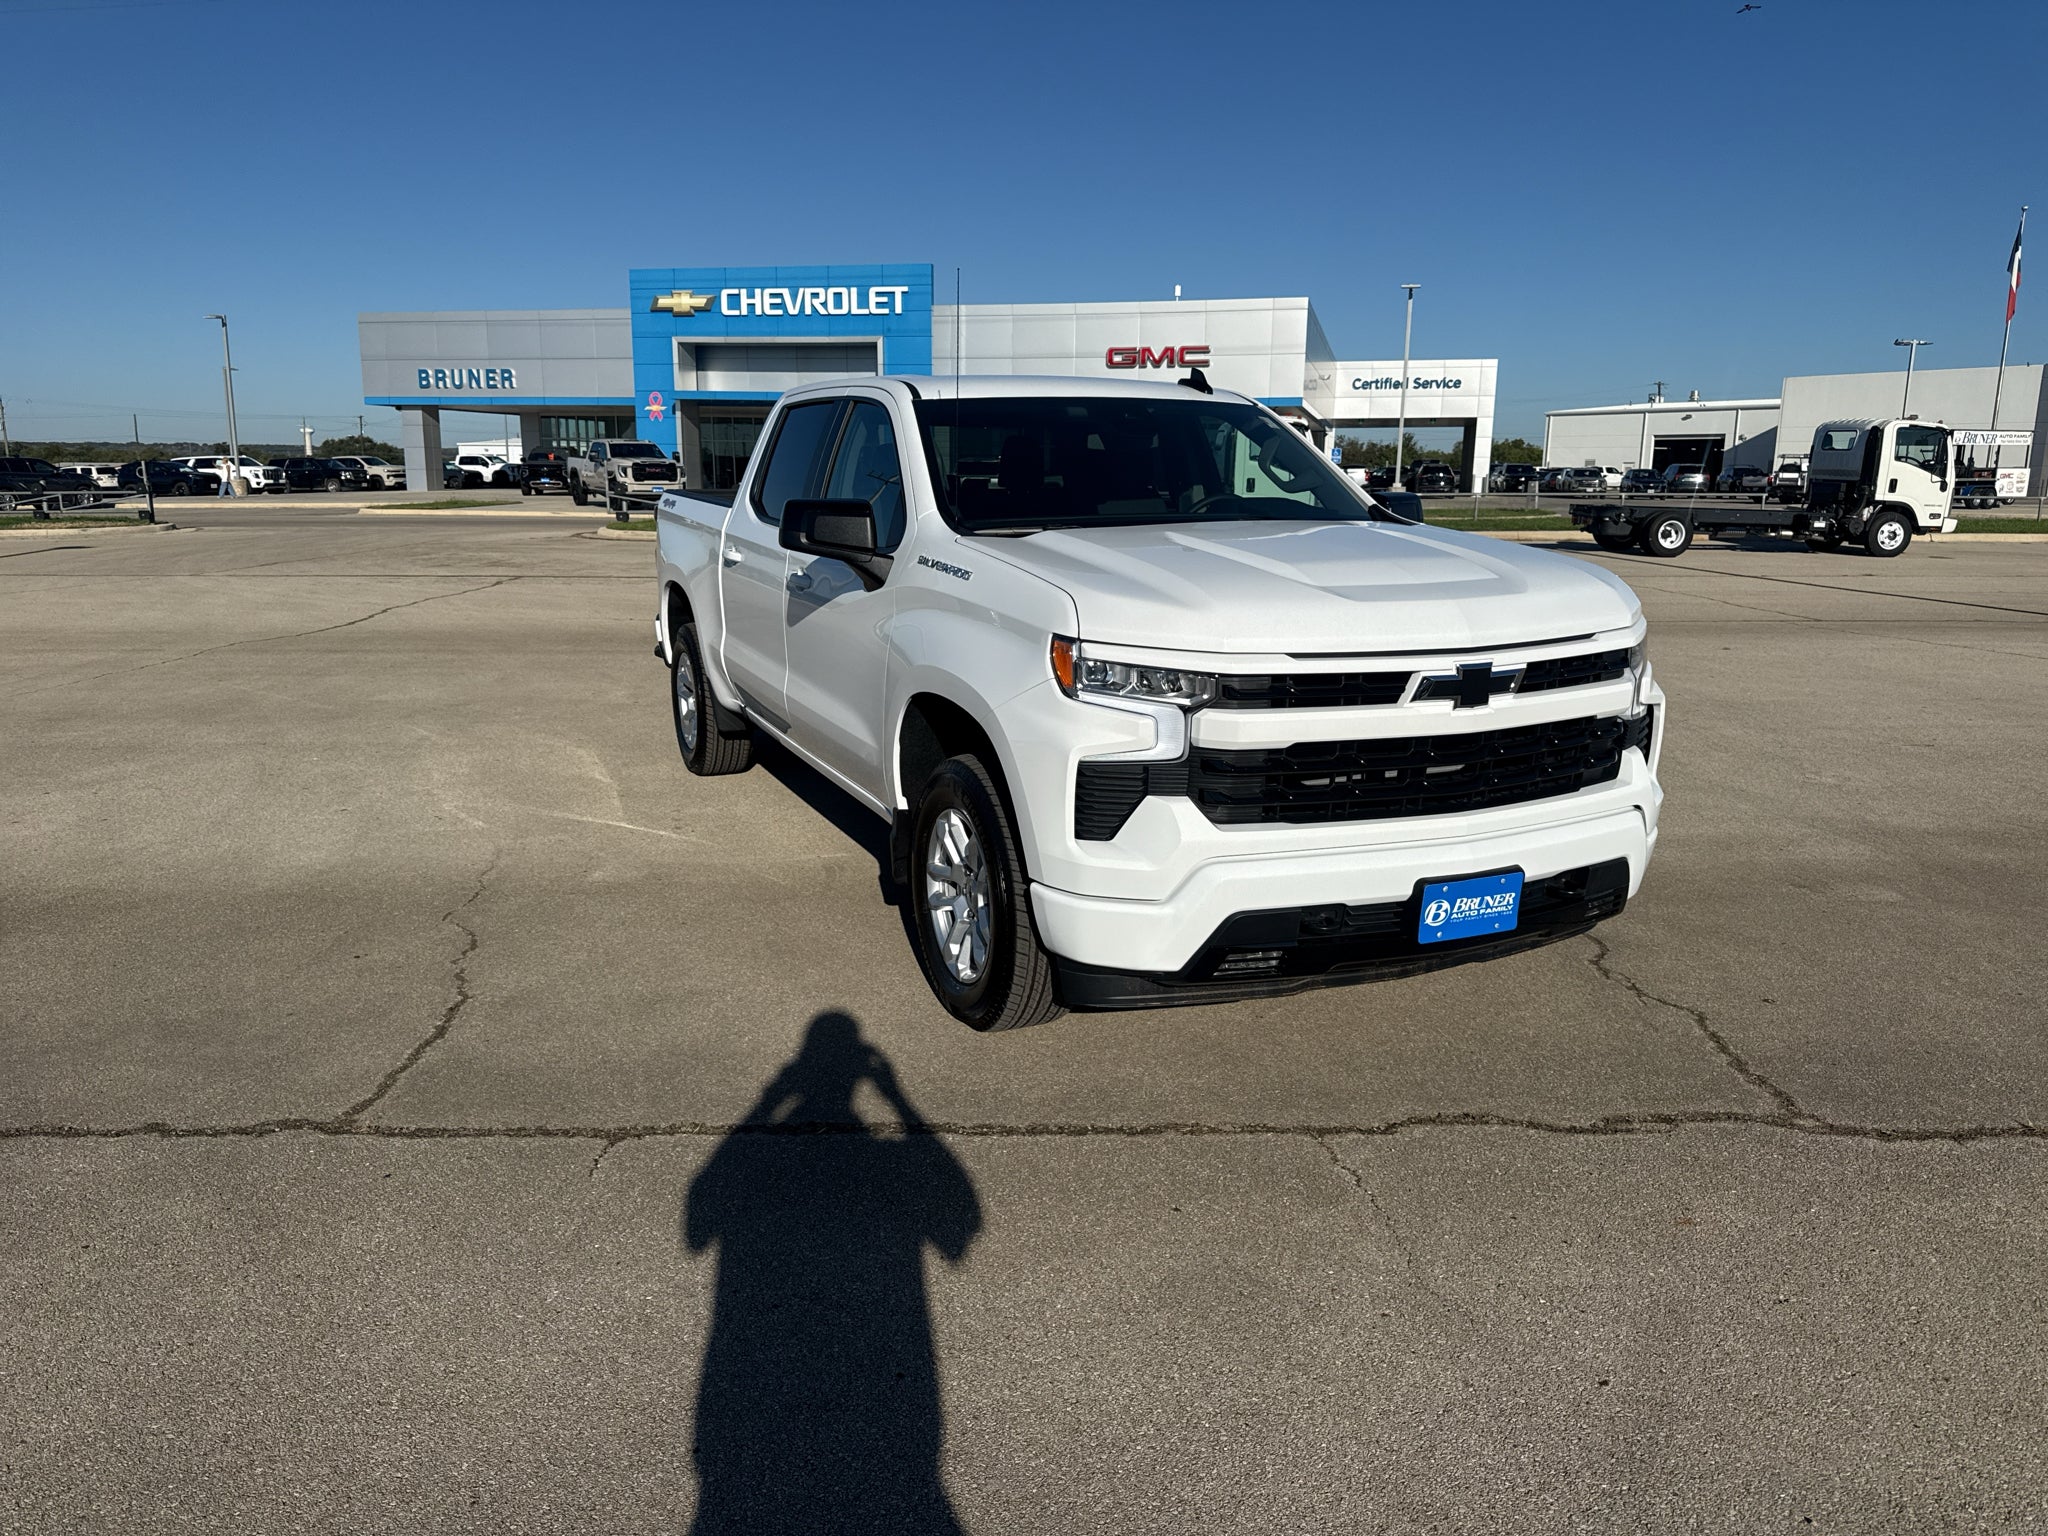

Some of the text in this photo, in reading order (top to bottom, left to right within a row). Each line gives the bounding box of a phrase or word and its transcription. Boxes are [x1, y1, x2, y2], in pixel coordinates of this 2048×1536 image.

[720, 285, 908, 317] CHEVROLET
[1105, 345, 1211, 369] GMC
[417, 367, 517, 391] BRUNER
[1352, 376, 1462, 390] Certified Service
[1962, 431, 1998, 444] BRUNER
[1450, 910, 1478, 919] AUTO
[1479, 905, 1513, 915] FAMILY
[1452, 892, 1516, 914] BRUNER
